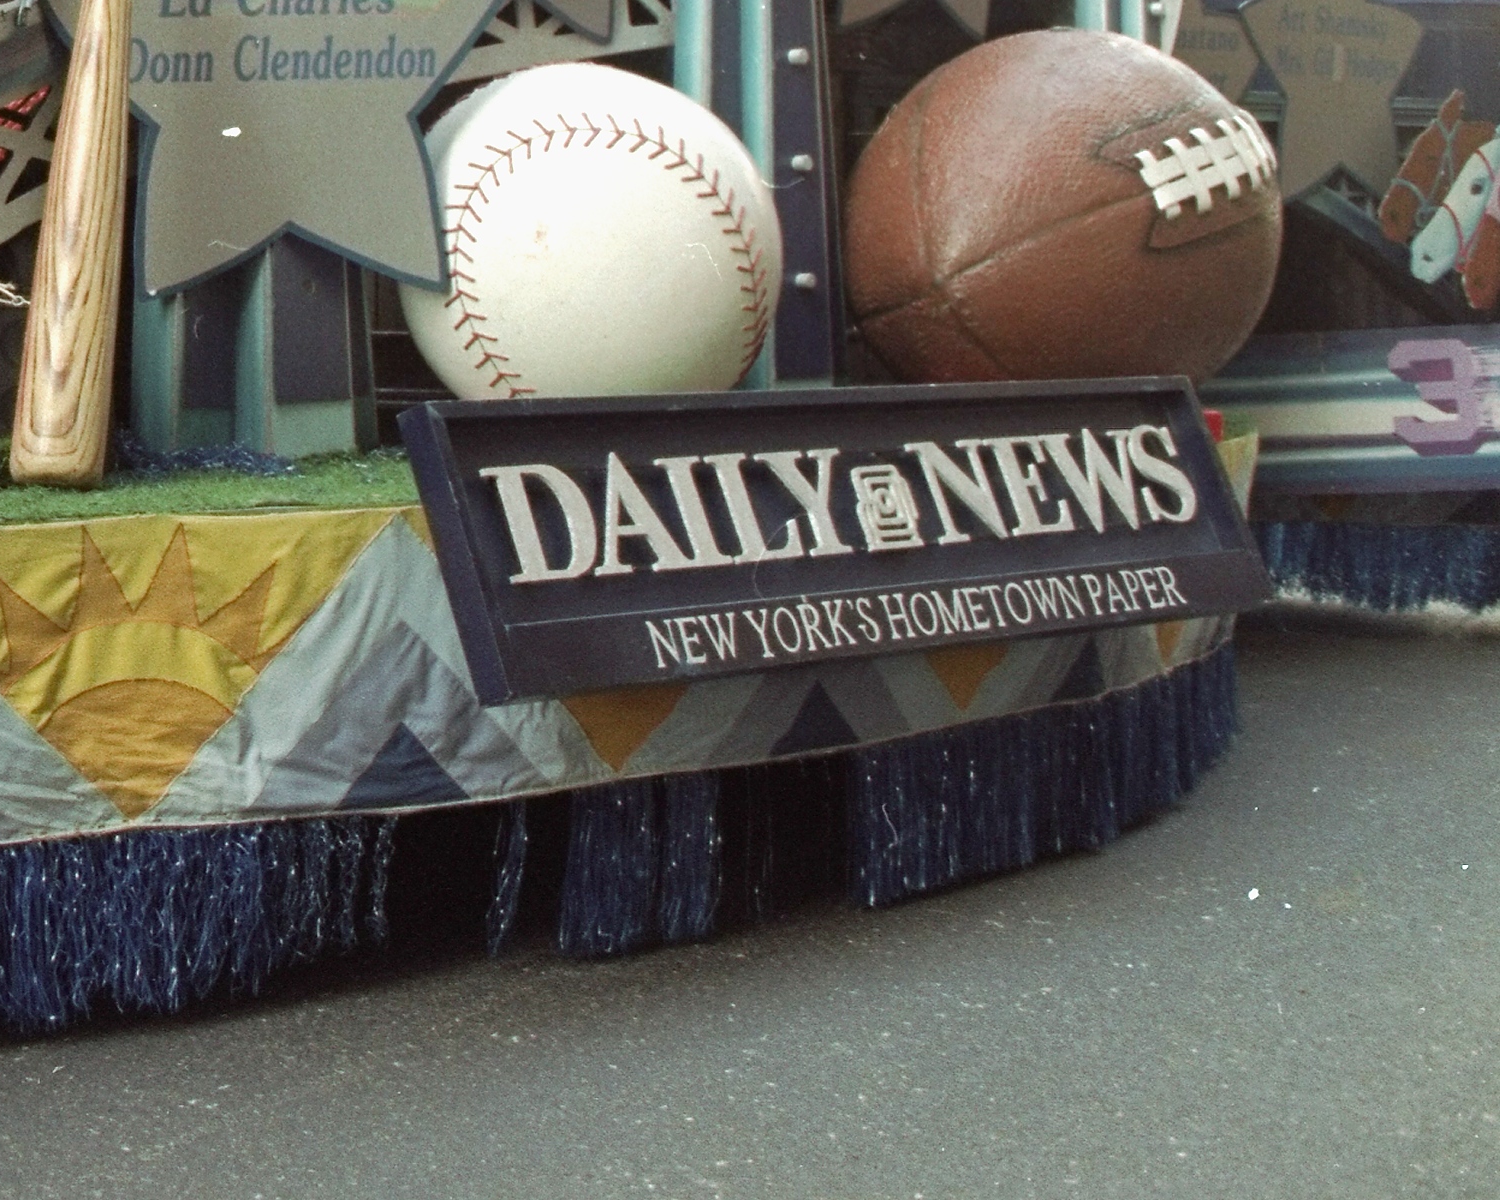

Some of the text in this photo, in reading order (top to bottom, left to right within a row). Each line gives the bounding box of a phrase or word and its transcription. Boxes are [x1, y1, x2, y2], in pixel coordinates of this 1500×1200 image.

[233, 32, 437, 83] Clendendon
[478, 424, 1198, 585] DAILY NEWS
[644, 566, 1188, 669] NEW YORK'S HOMETOWN PAPER
